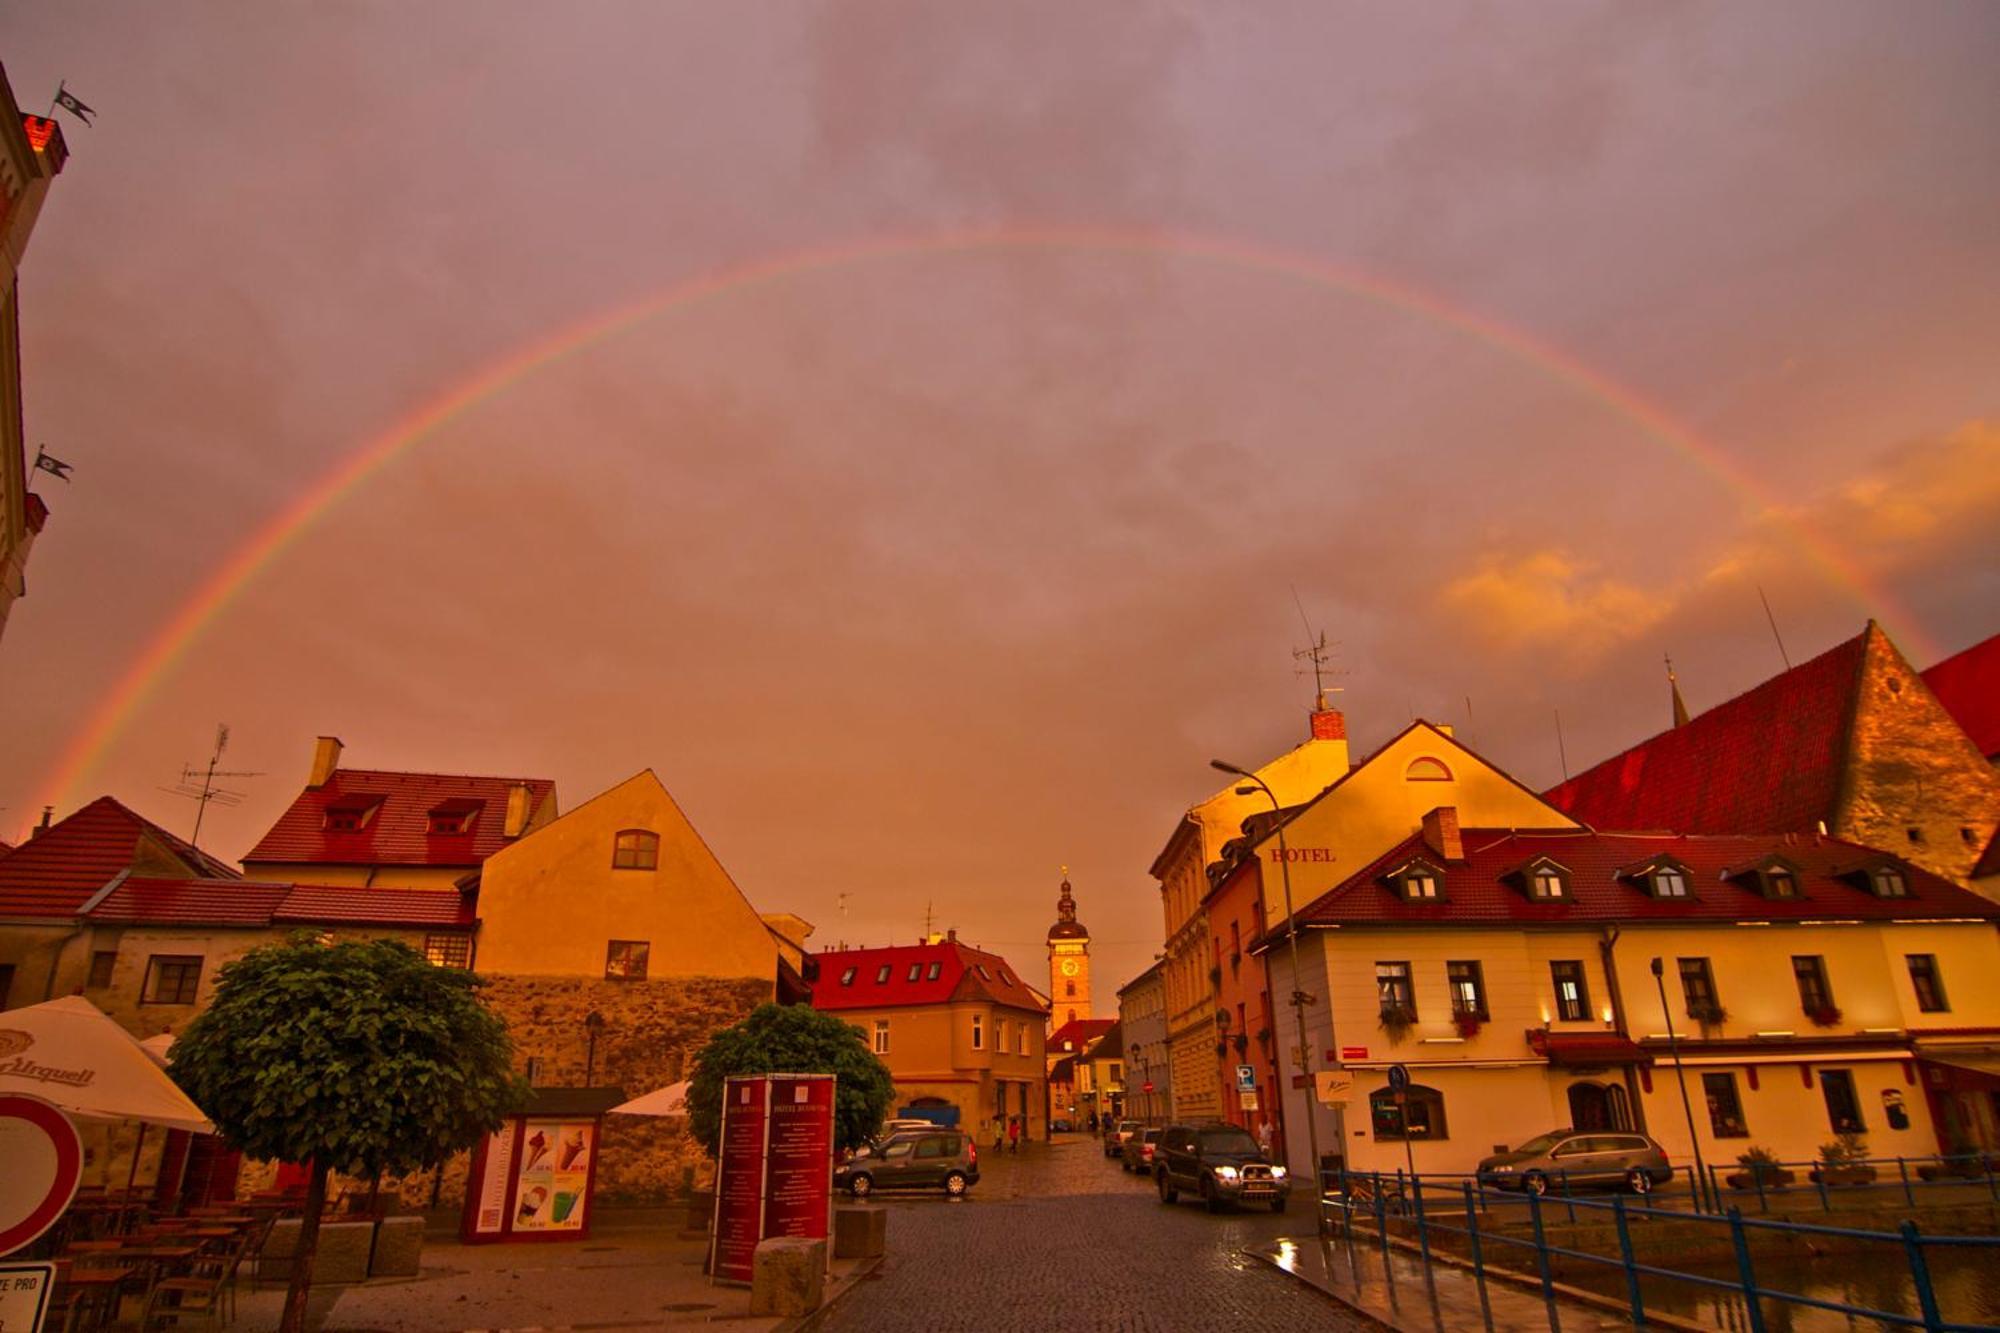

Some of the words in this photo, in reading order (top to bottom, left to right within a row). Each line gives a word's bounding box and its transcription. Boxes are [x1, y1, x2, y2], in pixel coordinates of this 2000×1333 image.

[1271, 848, 1336, 863] HOTEL
[11, 1057, 96, 1083] Urquell
[1239, 1068, 1250, 1082] P
[14, 1277, 38, 1291] PRO
